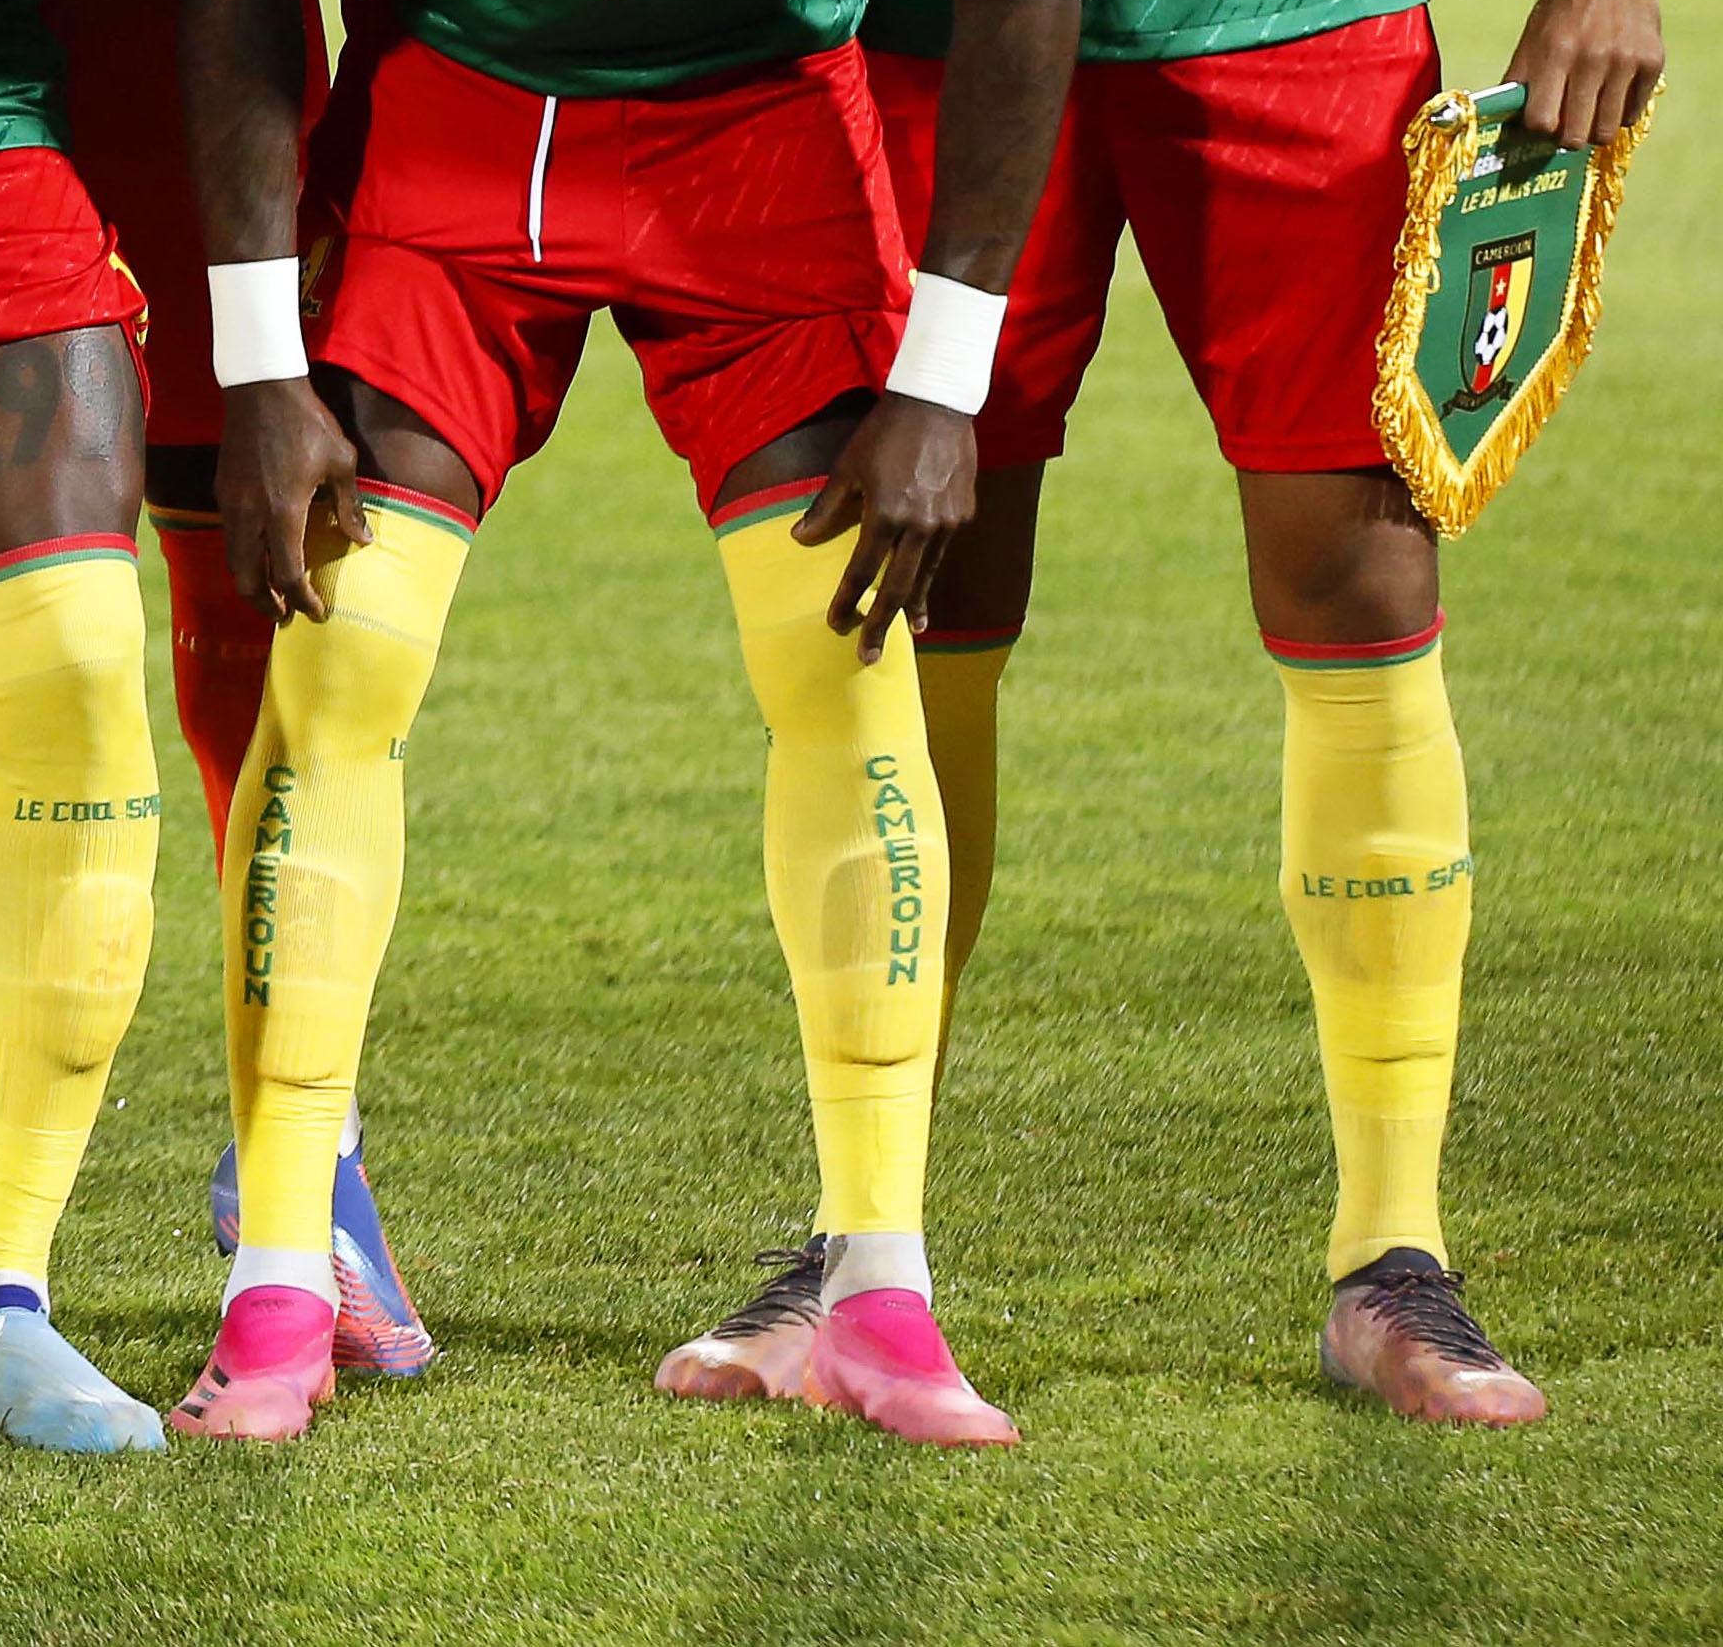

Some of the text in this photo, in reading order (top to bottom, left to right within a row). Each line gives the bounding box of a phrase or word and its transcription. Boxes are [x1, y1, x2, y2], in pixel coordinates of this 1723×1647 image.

[1461, 190, 1478, 214] LE
[1478, 184, 1498, 209] 29
[1533, 169, 1568, 195] 2022
[1475, 239, 1532, 264] CAMEROUN
[15, 799, 42, 822] LE
[52, 800, 114, 822] COQ
[243, 767, 295, 1007] CAMEROUN
[866, 755, 919, 988] CAMEROUN
[1304, 872, 1335, 898] LE
